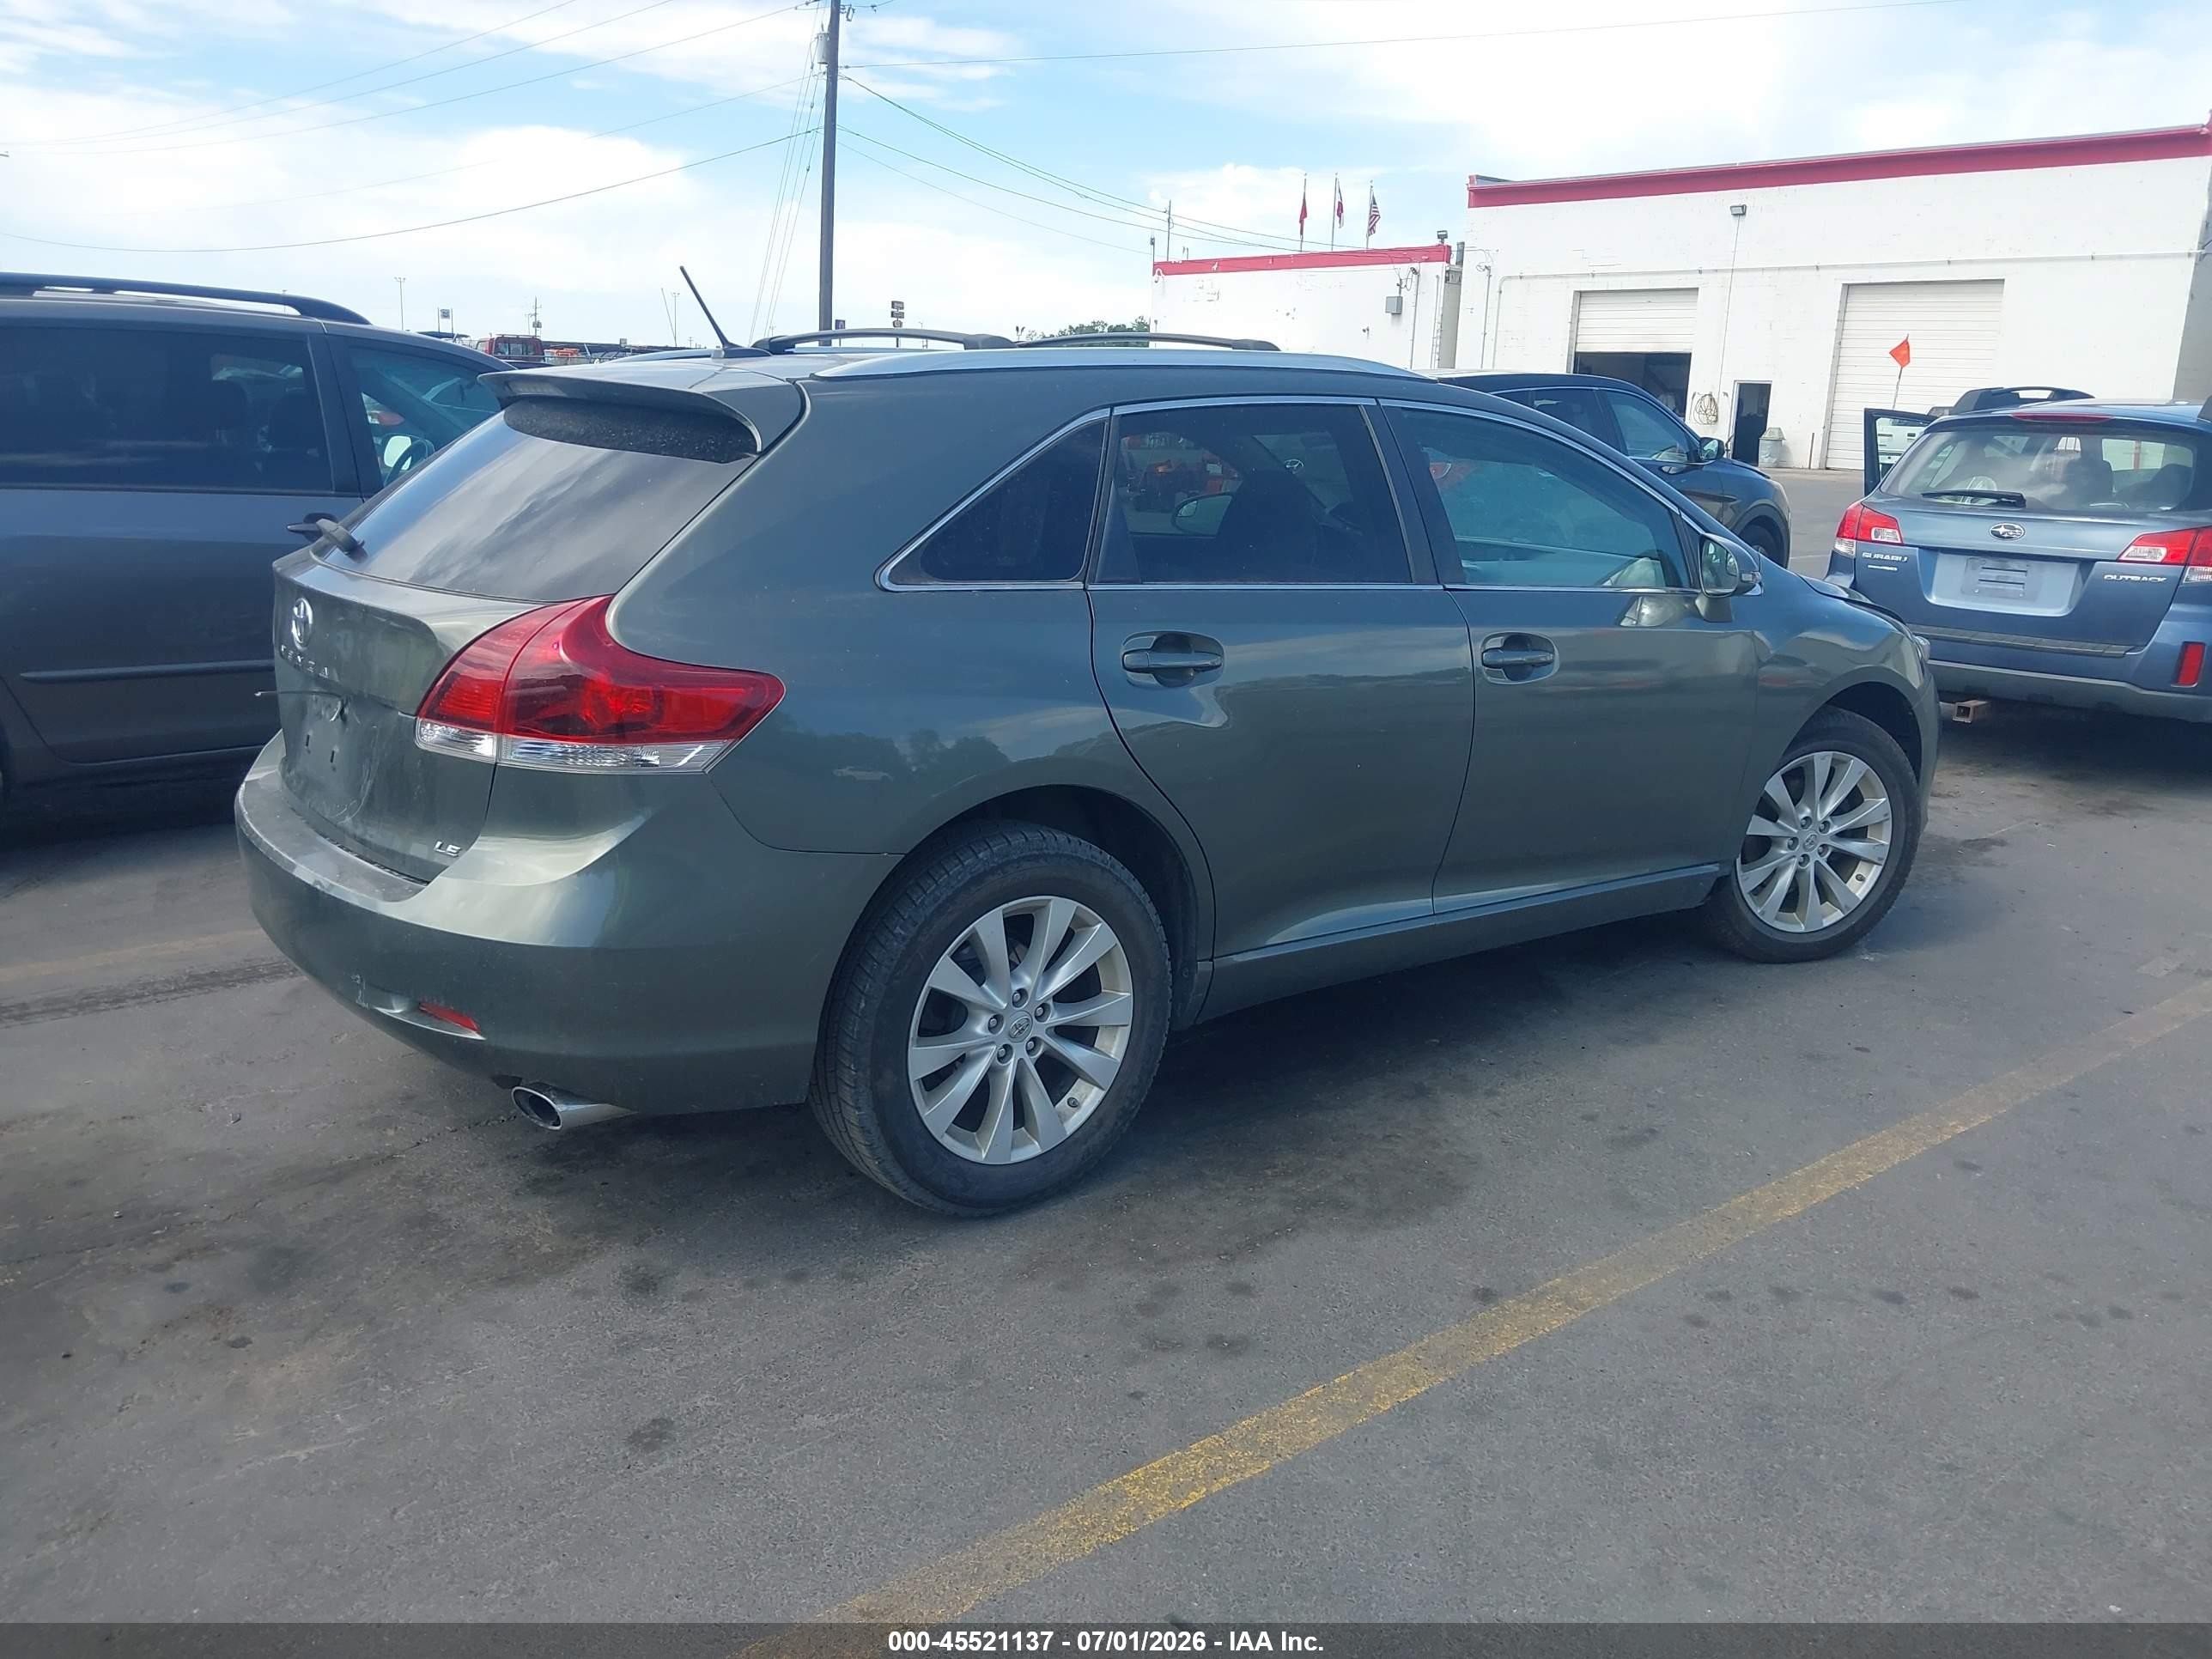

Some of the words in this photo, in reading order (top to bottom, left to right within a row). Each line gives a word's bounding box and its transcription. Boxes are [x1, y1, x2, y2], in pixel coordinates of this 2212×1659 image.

[1862, 551, 1908, 562] SUBARU
[2104, 574, 2167, 583] OUTBACK
[434, 841, 461, 857] LE
